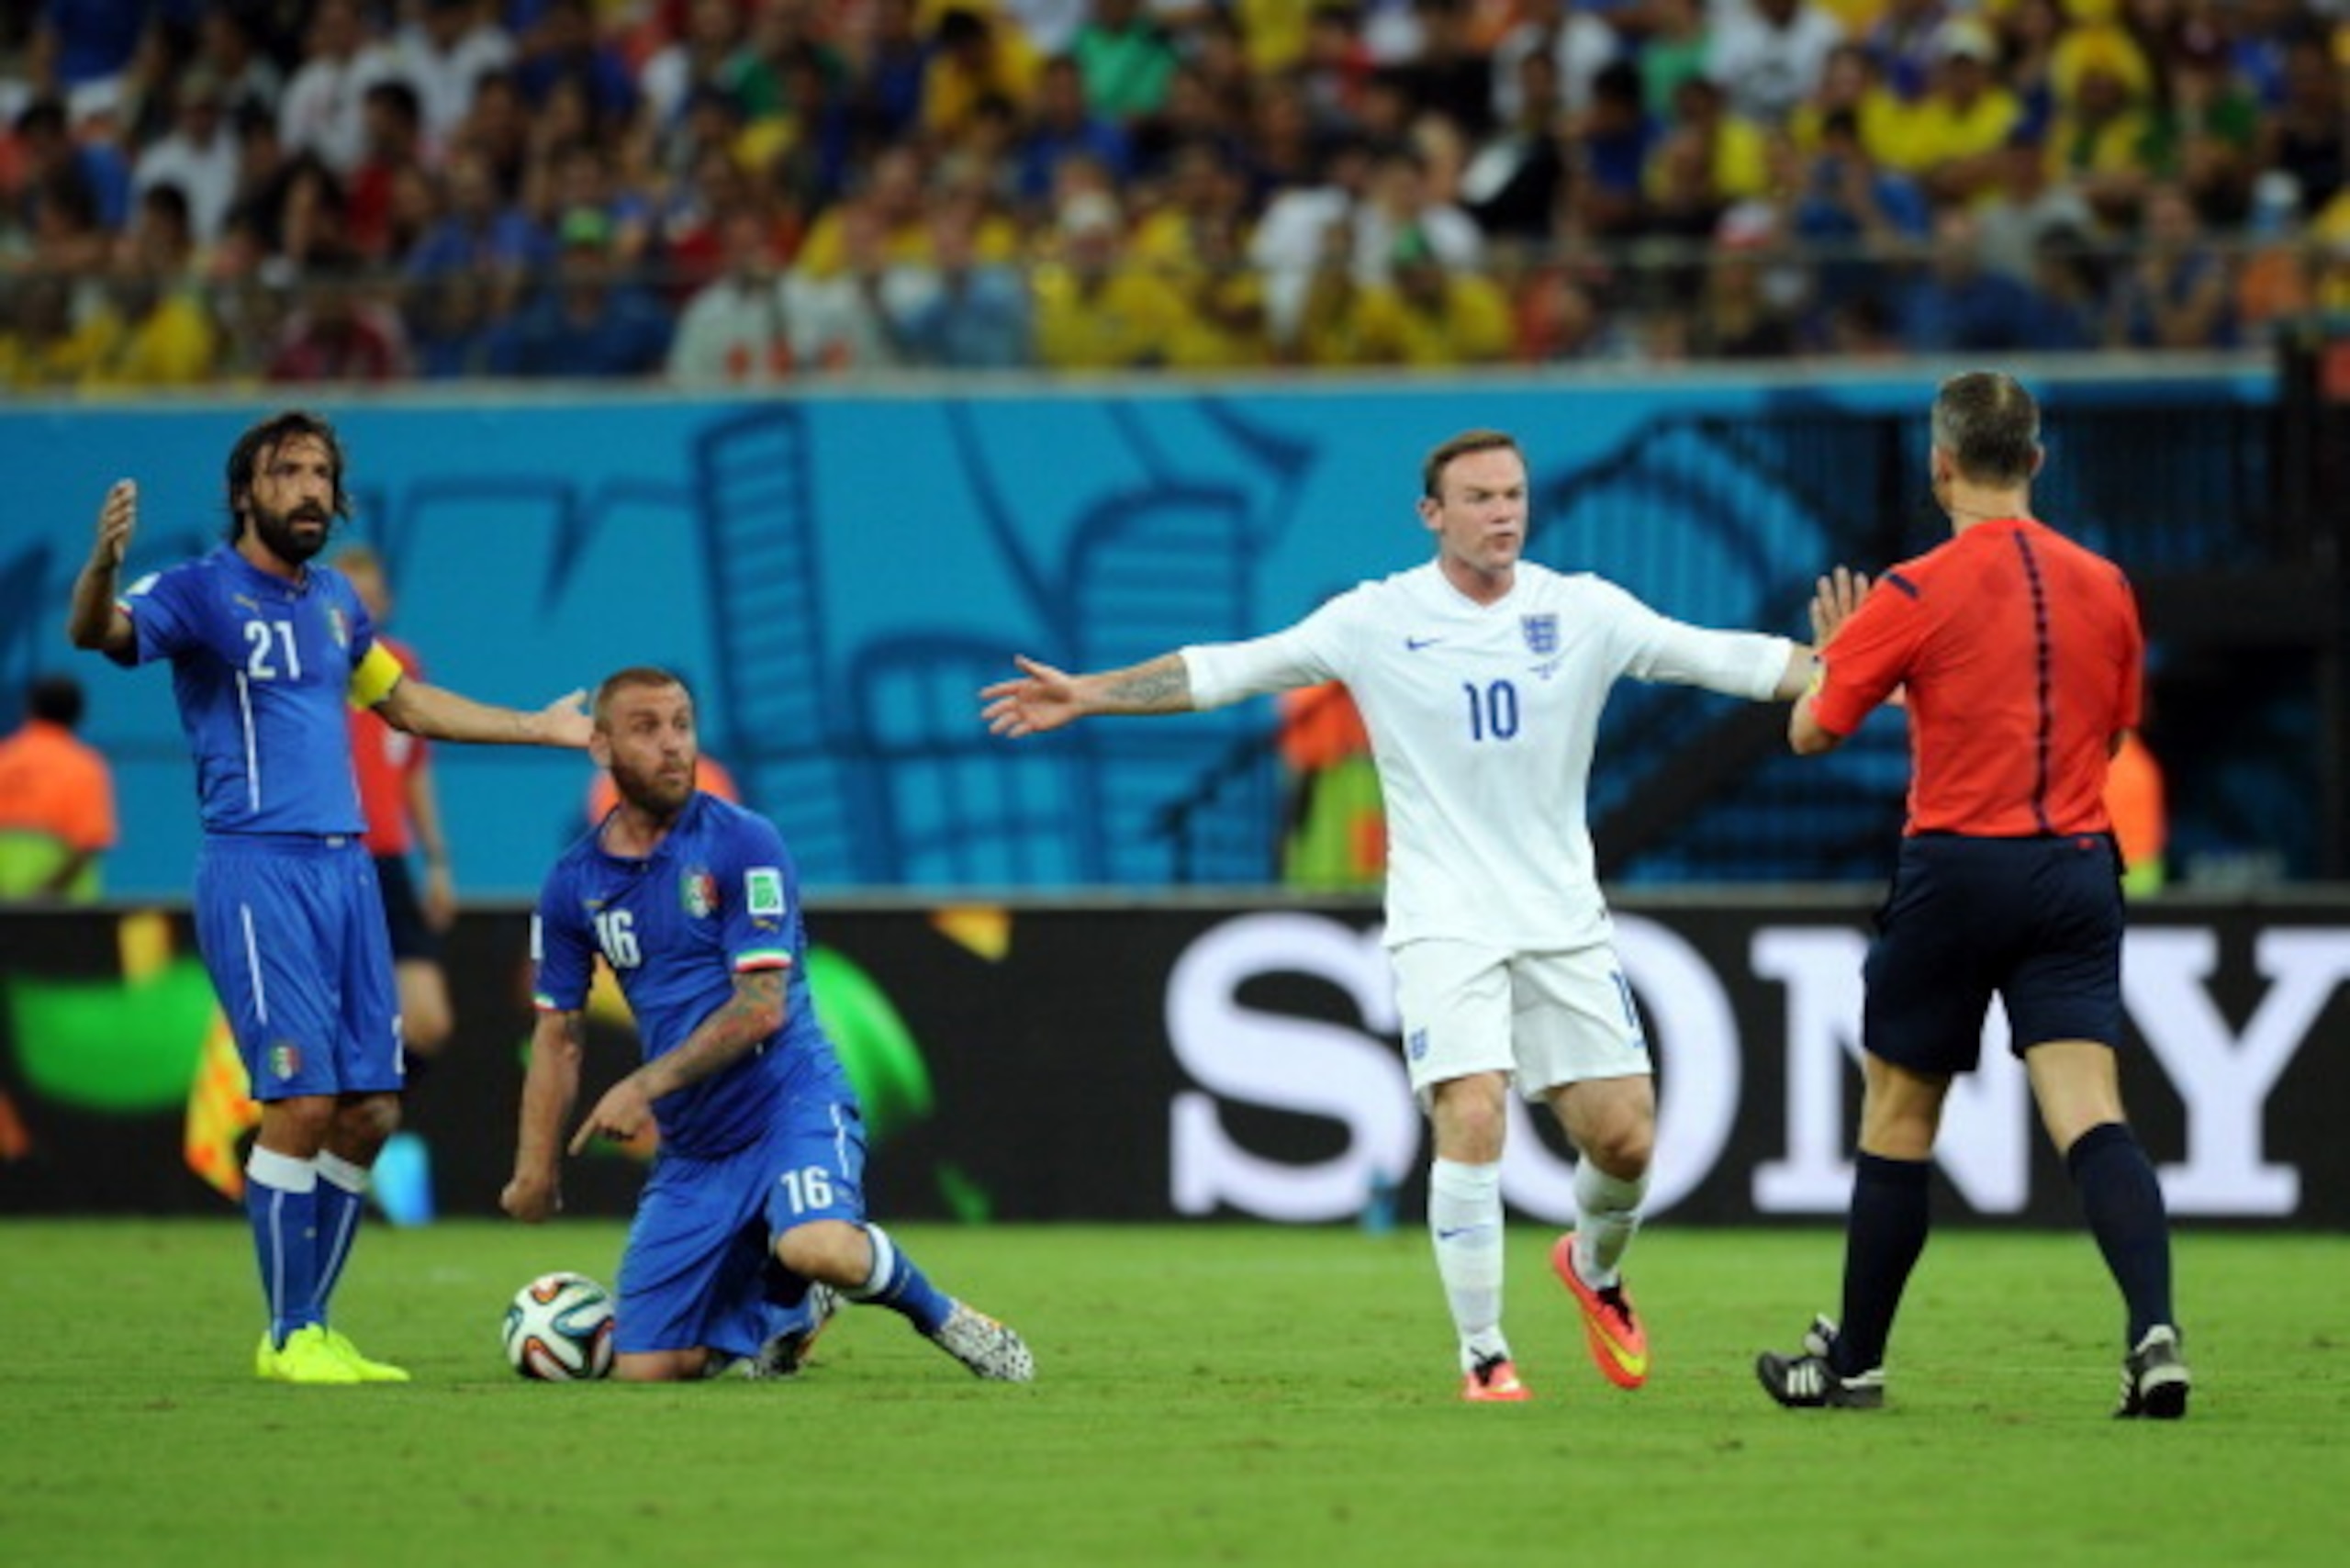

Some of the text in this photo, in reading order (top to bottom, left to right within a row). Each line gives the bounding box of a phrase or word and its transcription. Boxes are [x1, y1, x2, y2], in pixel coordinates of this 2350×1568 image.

[243, 620, 301, 680] 21
[1462, 679, 1519, 742] 10
[592, 909, 642, 969] 16
[780, 1166, 834, 1214] 16
